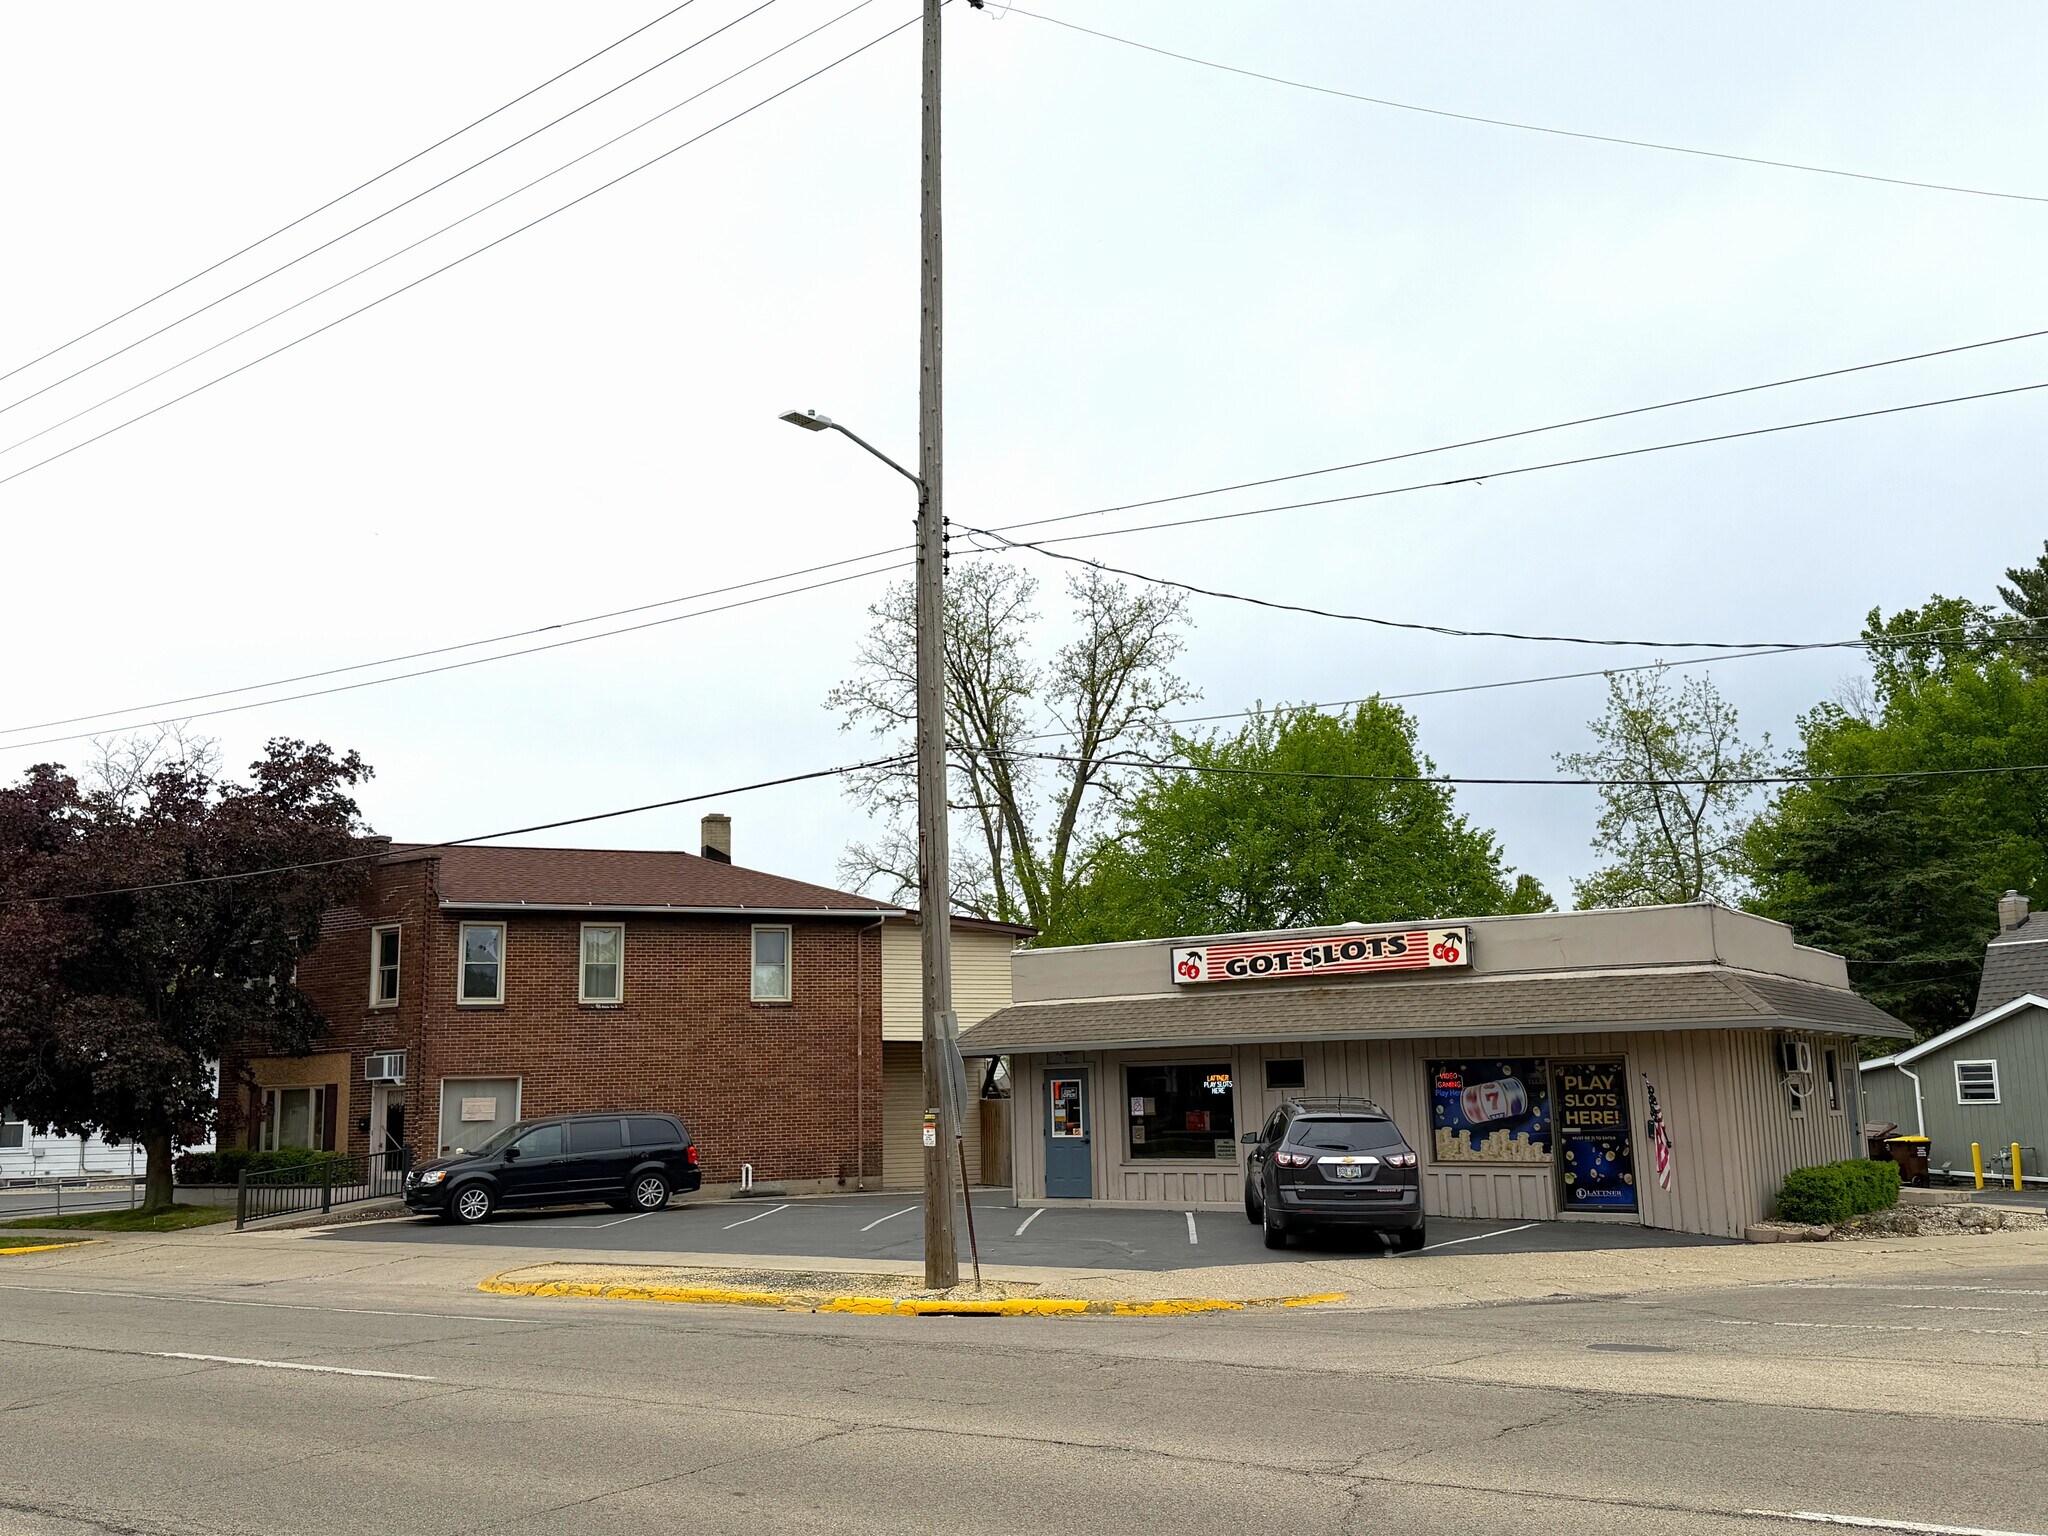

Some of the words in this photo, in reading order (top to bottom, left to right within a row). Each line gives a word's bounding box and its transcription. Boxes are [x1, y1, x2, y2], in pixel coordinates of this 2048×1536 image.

[1225, 952, 1293, 976] GOT
[1303, 935, 1408, 967] SLOTS
[1564, 1075, 1615, 1090] PLAY
[1485, 1091, 1499, 1111] 7
[1564, 1093, 1618, 1107] SLOTS
[1565, 1110, 1620, 1125] HERE!
